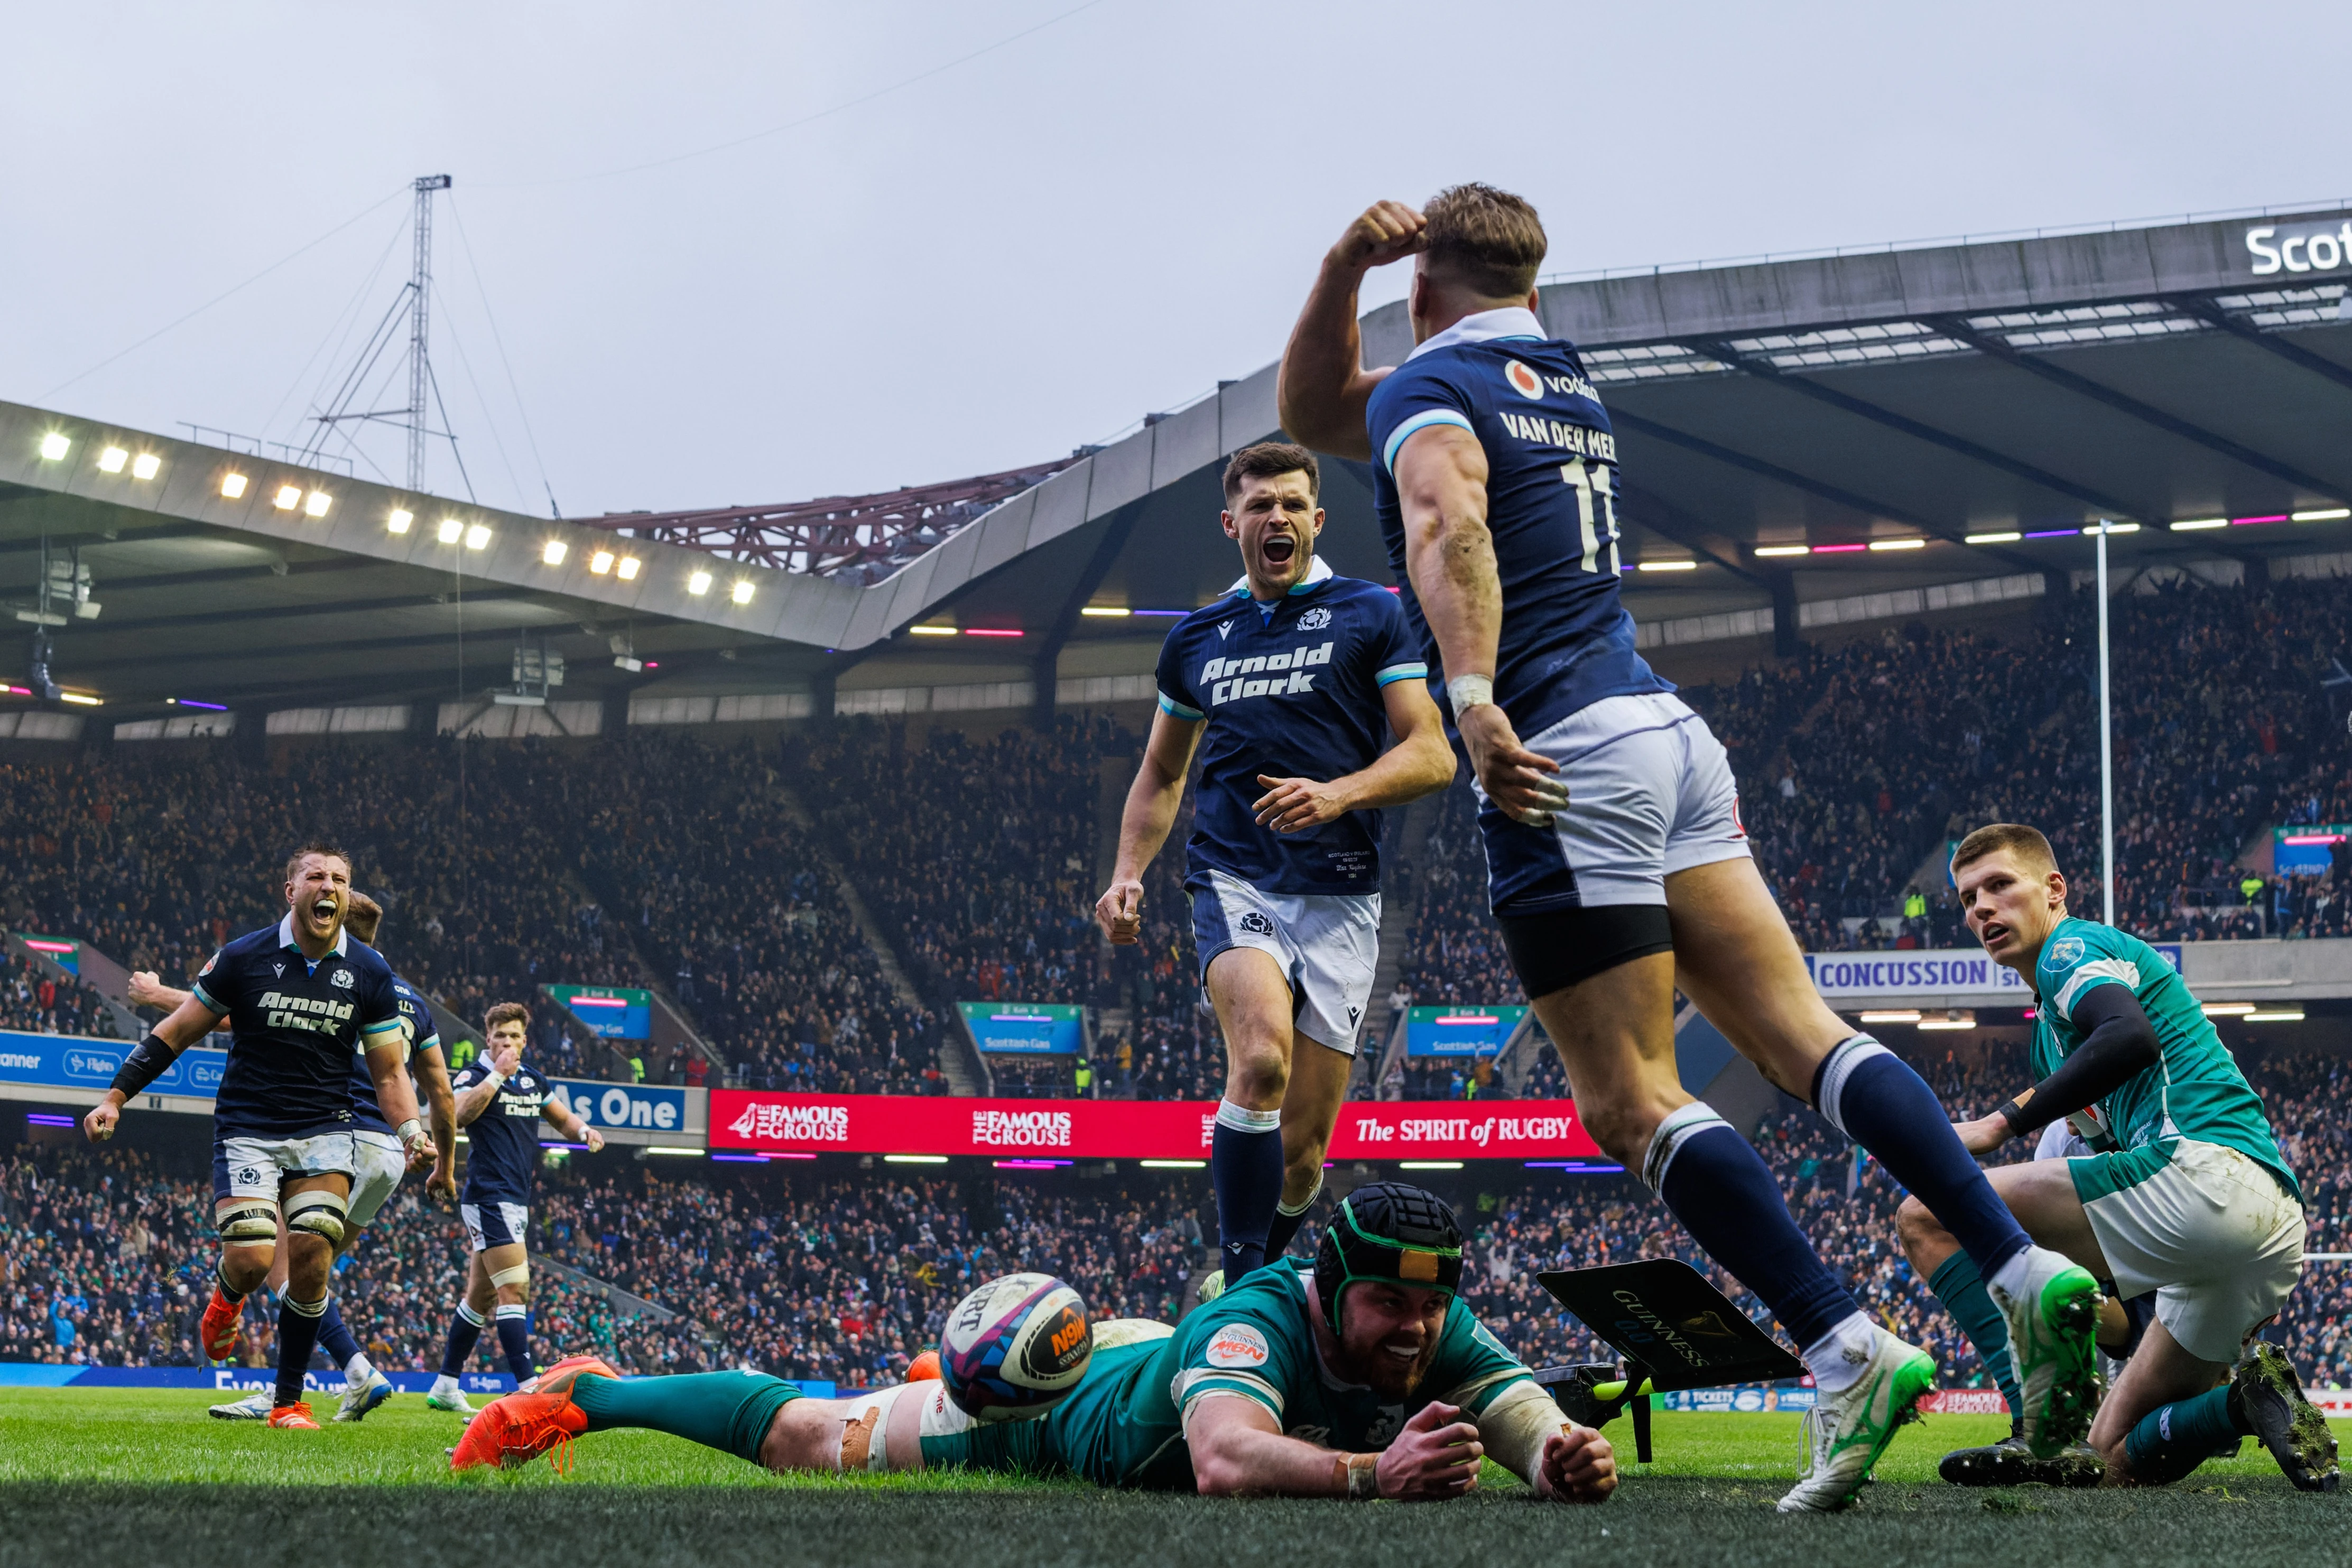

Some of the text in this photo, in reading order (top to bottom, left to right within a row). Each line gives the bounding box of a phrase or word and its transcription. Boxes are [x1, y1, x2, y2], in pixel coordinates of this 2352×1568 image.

[1499, 412, 1550, 444] VAN
[1550, 421, 1586, 454] DER
[1560, 454, 1621, 578] 11
[1199, 642, 1334, 686] Arnold
[1212, 671, 1316, 706] Clark
[1820, 960, 1987, 987] CONCUSSION
[257, 991, 354, 1020] Arnold
[267, 1011, 340, 1036] Clark
[498, 1092, 542, 1105] Arnold
[505, 1103, 540, 1117] Clark
[600, 1088, 677, 1128] One
[756, 1104, 770, 1138] THE
[770, 1105, 848, 1125] FAMOUS
[973, 1110, 987, 1144] THE
[987, 1111, 1071, 1130] FAMOUS
[768, 1122, 848, 1141] GROUSE
[986, 1128, 1071, 1146] GROUSE
[1356, 1117, 1572, 1147] The SPIRIT of RUGBY
[1227, 1333, 1265, 1352] GUINNESS
[1613, 1290, 1710, 1367] GUINNESS
[1692, 1391, 1735, 1404] TICKETS
